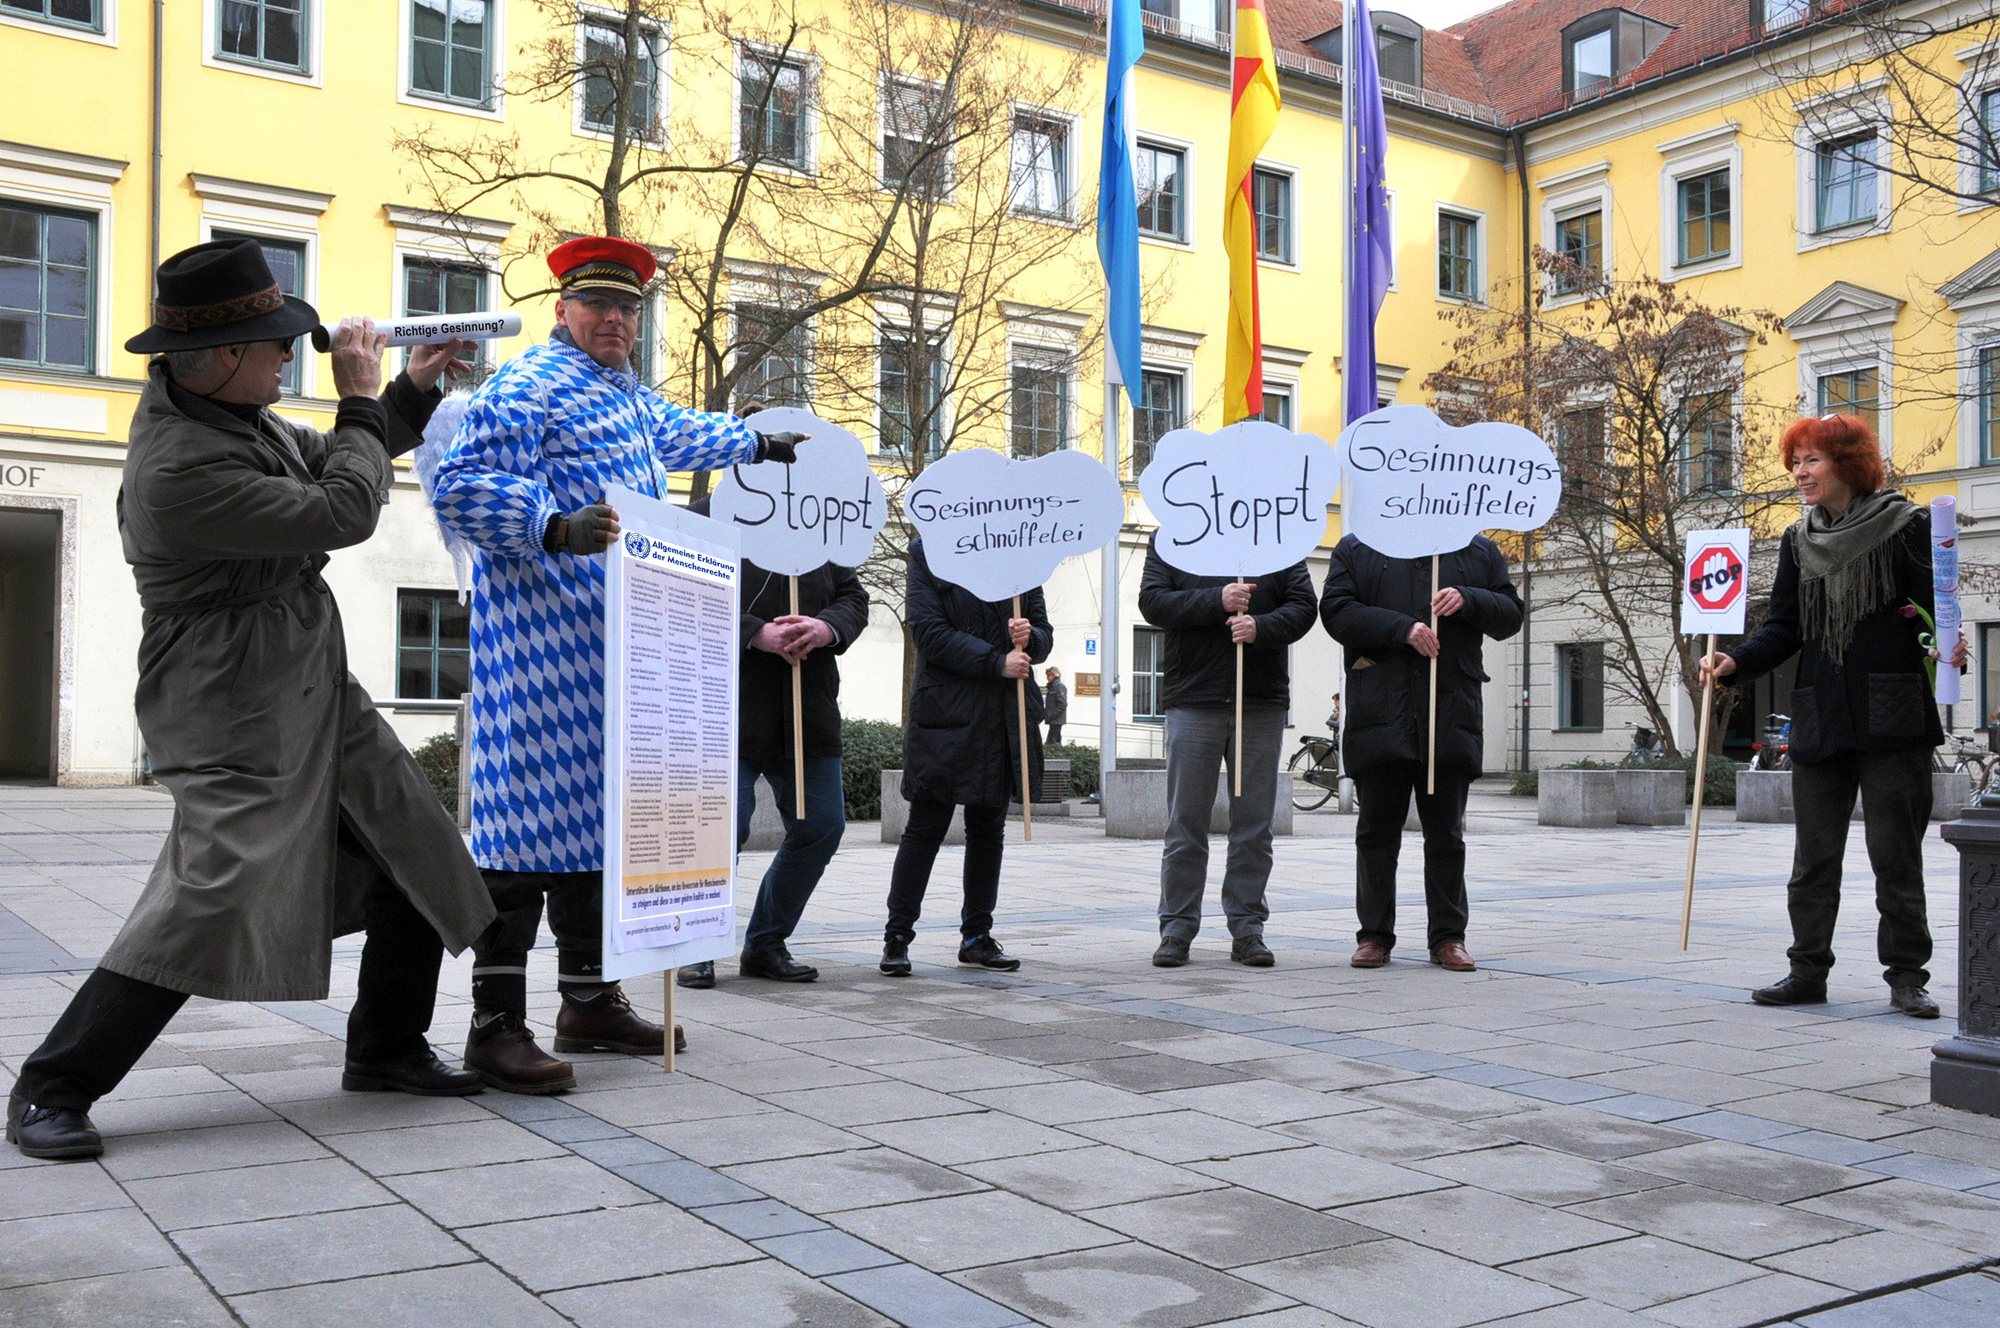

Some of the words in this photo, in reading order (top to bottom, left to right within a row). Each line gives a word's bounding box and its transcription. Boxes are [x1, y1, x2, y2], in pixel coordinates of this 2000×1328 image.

[394, 324, 438, 338] Richtige
[440, 319, 505, 334] Gesinnung?
[1348, 420, 1560, 485] Gesinnungs-
[0, 464, 46, 488] OF
[733, 462, 873, 546] Stoppt
[909, 489, 1082, 523] Gesinnungs-
[1162, 454, 1318, 547] Stoppt
[1379, 481, 1538, 519] schnüffelei
[954, 520, 1085, 555] schnüffelei
[652, 540, 695, 560] Allgemeine
[697, 553, 735, 573] Erklärung
[652, 551, 666, 561] der
[667, 555, 731, 580] Menschenrechte
[1690, 563, 1743, 595] STOP
